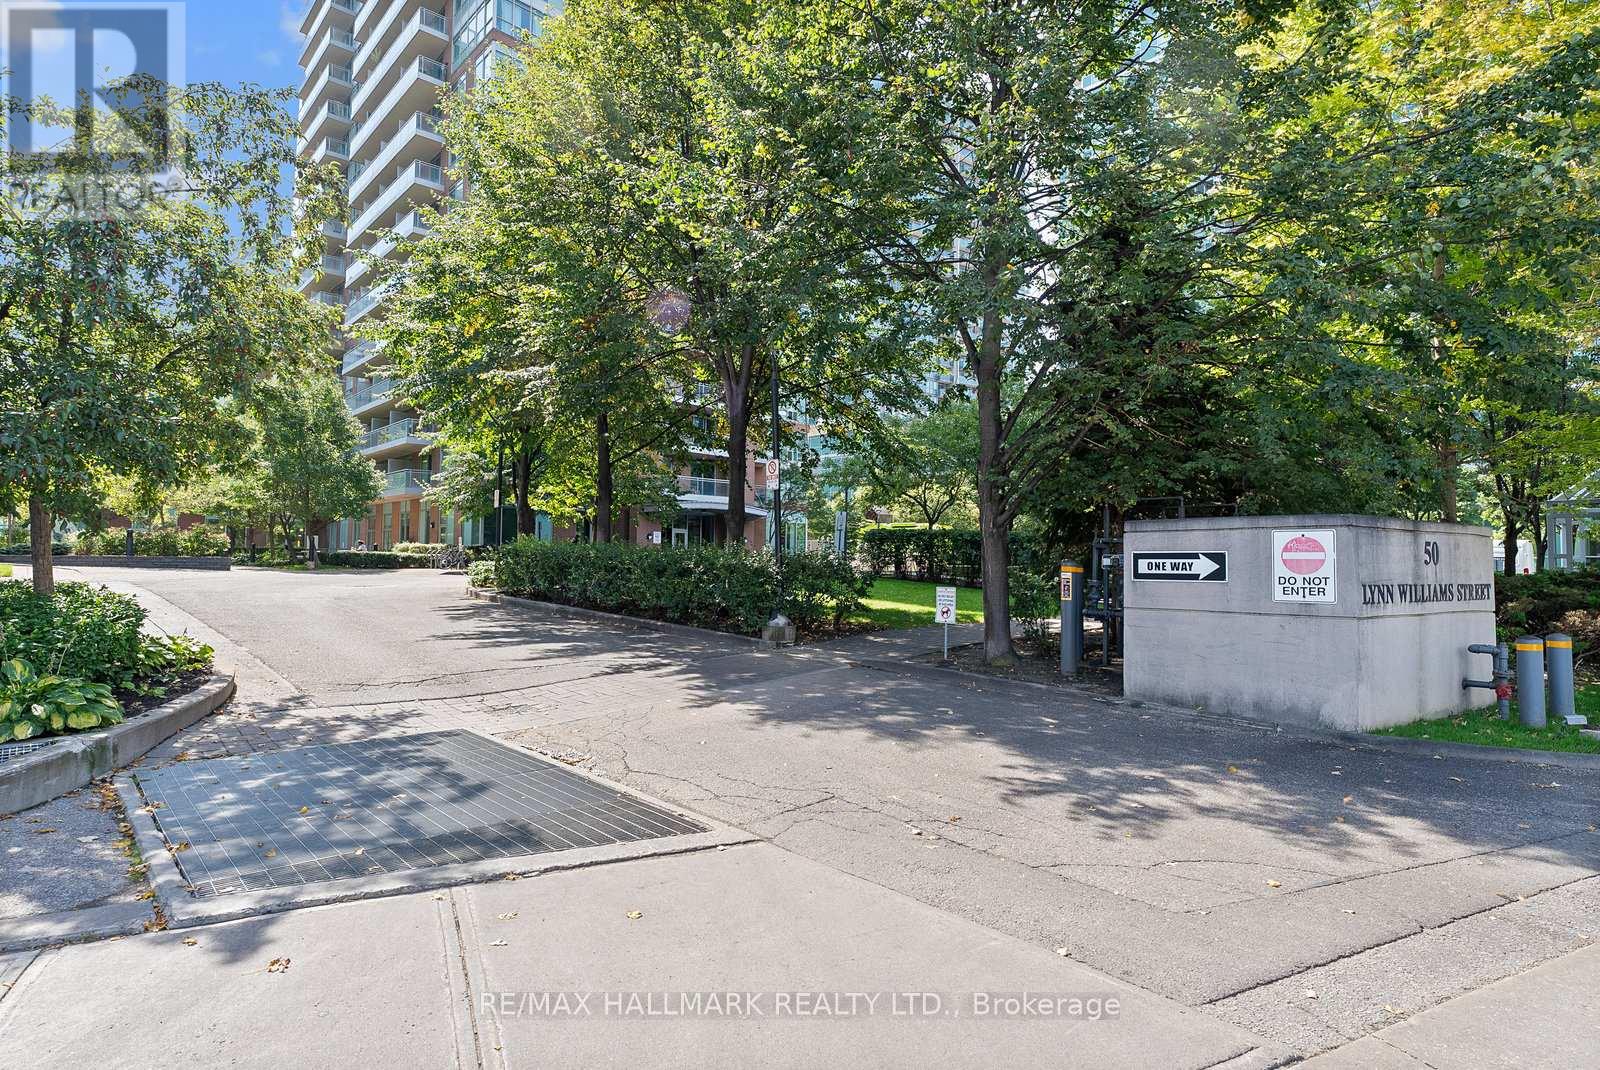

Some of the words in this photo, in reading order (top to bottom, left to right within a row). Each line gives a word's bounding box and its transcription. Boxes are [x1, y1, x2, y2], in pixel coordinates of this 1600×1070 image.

[1424, 541, 1439, 566] 50
[1147, 561, 1167, 571] ONE
[1170, 561, 1194, 571] WAY
[1278, 576, 1297, 586] DO
[1302, 576, 1330, 586] NOT
[1282, 587, 1326, 597] ENTER
[1362, 584, 1394, 605] LYNN
[1397, 584, 1454, 604] WILLIAMS
[1456, 584, 1492, 601] STREET
